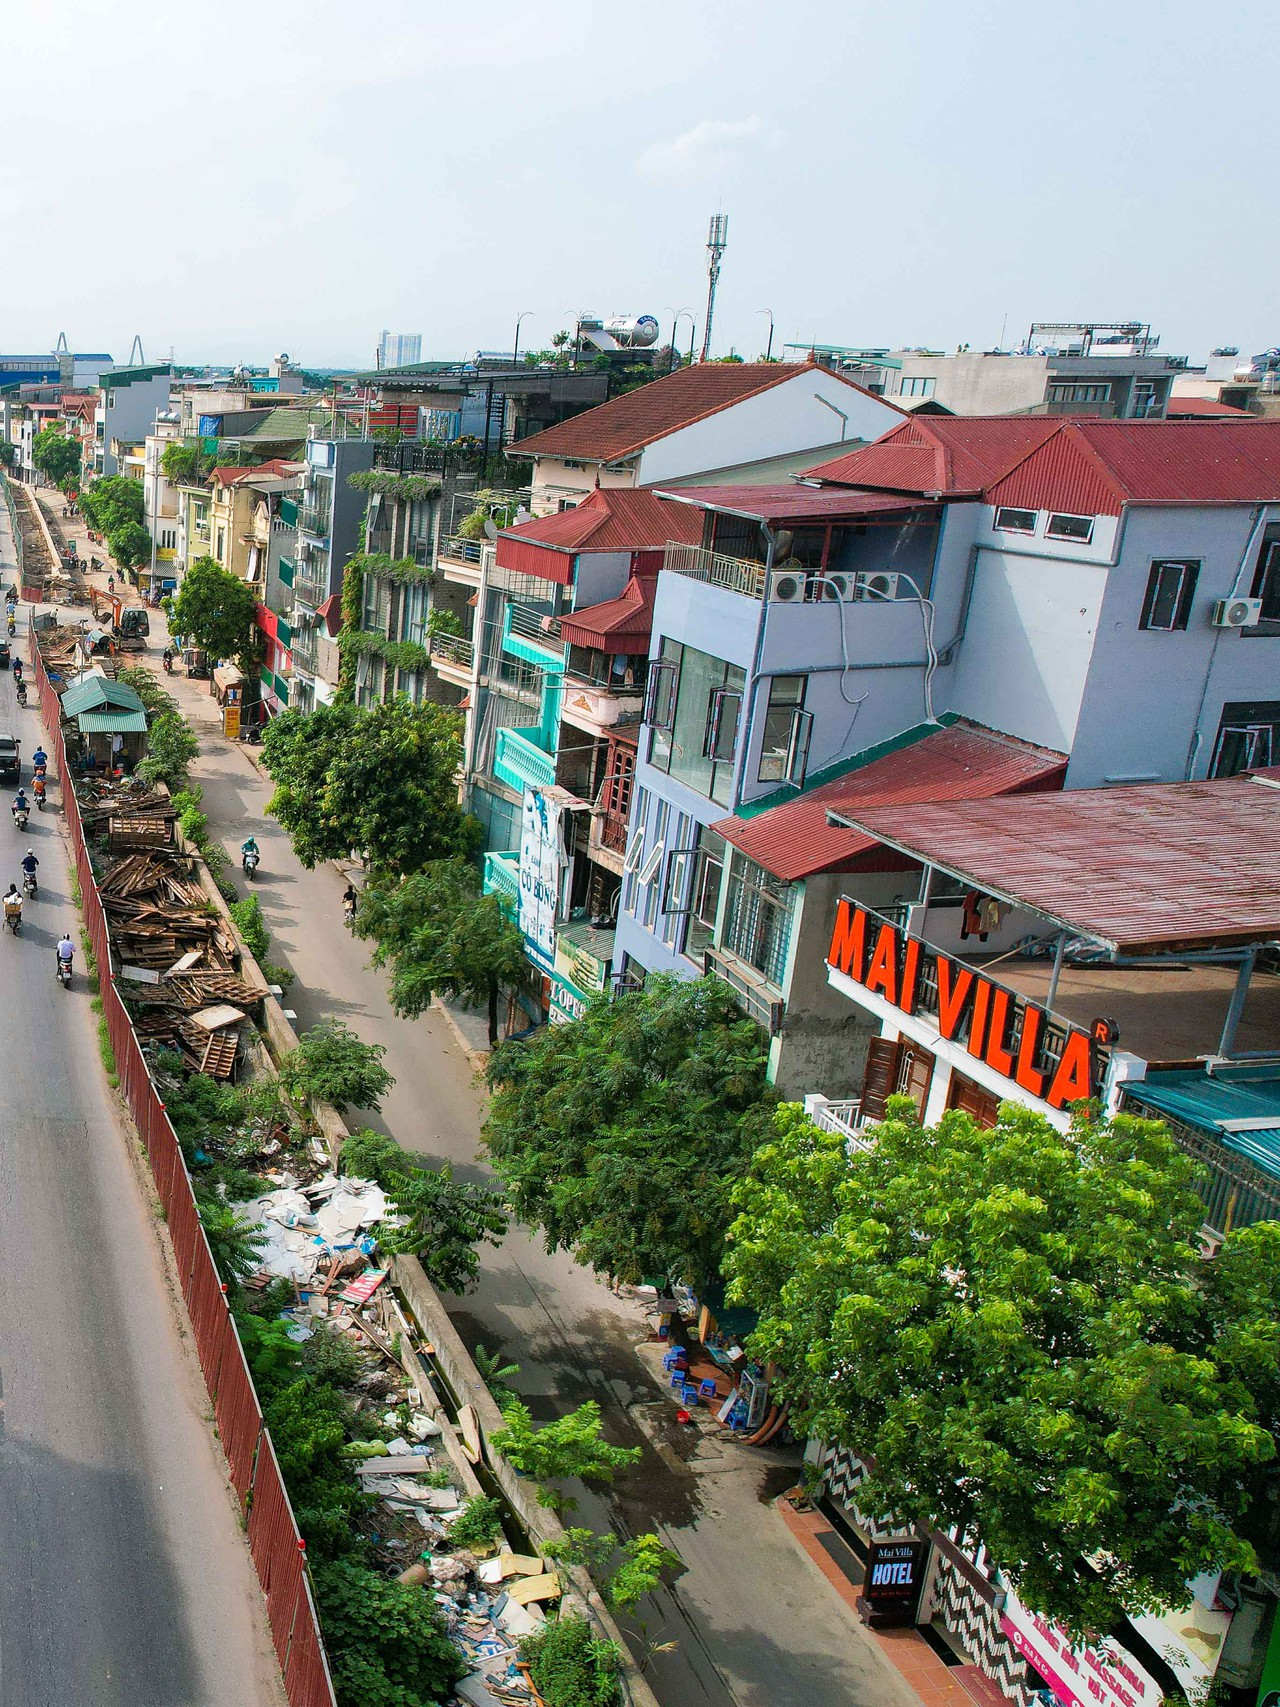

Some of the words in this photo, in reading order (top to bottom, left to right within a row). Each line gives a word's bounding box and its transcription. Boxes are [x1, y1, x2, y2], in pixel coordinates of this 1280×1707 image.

[827, 898, 923, 1015] MAI
[936, 954, 1094, 1115] VILLA
[878, 1548, 894, 1557] Mai
[895, 1547, 913, 1556] Villa
[871, 1562, 913, 1585] HOTEL
